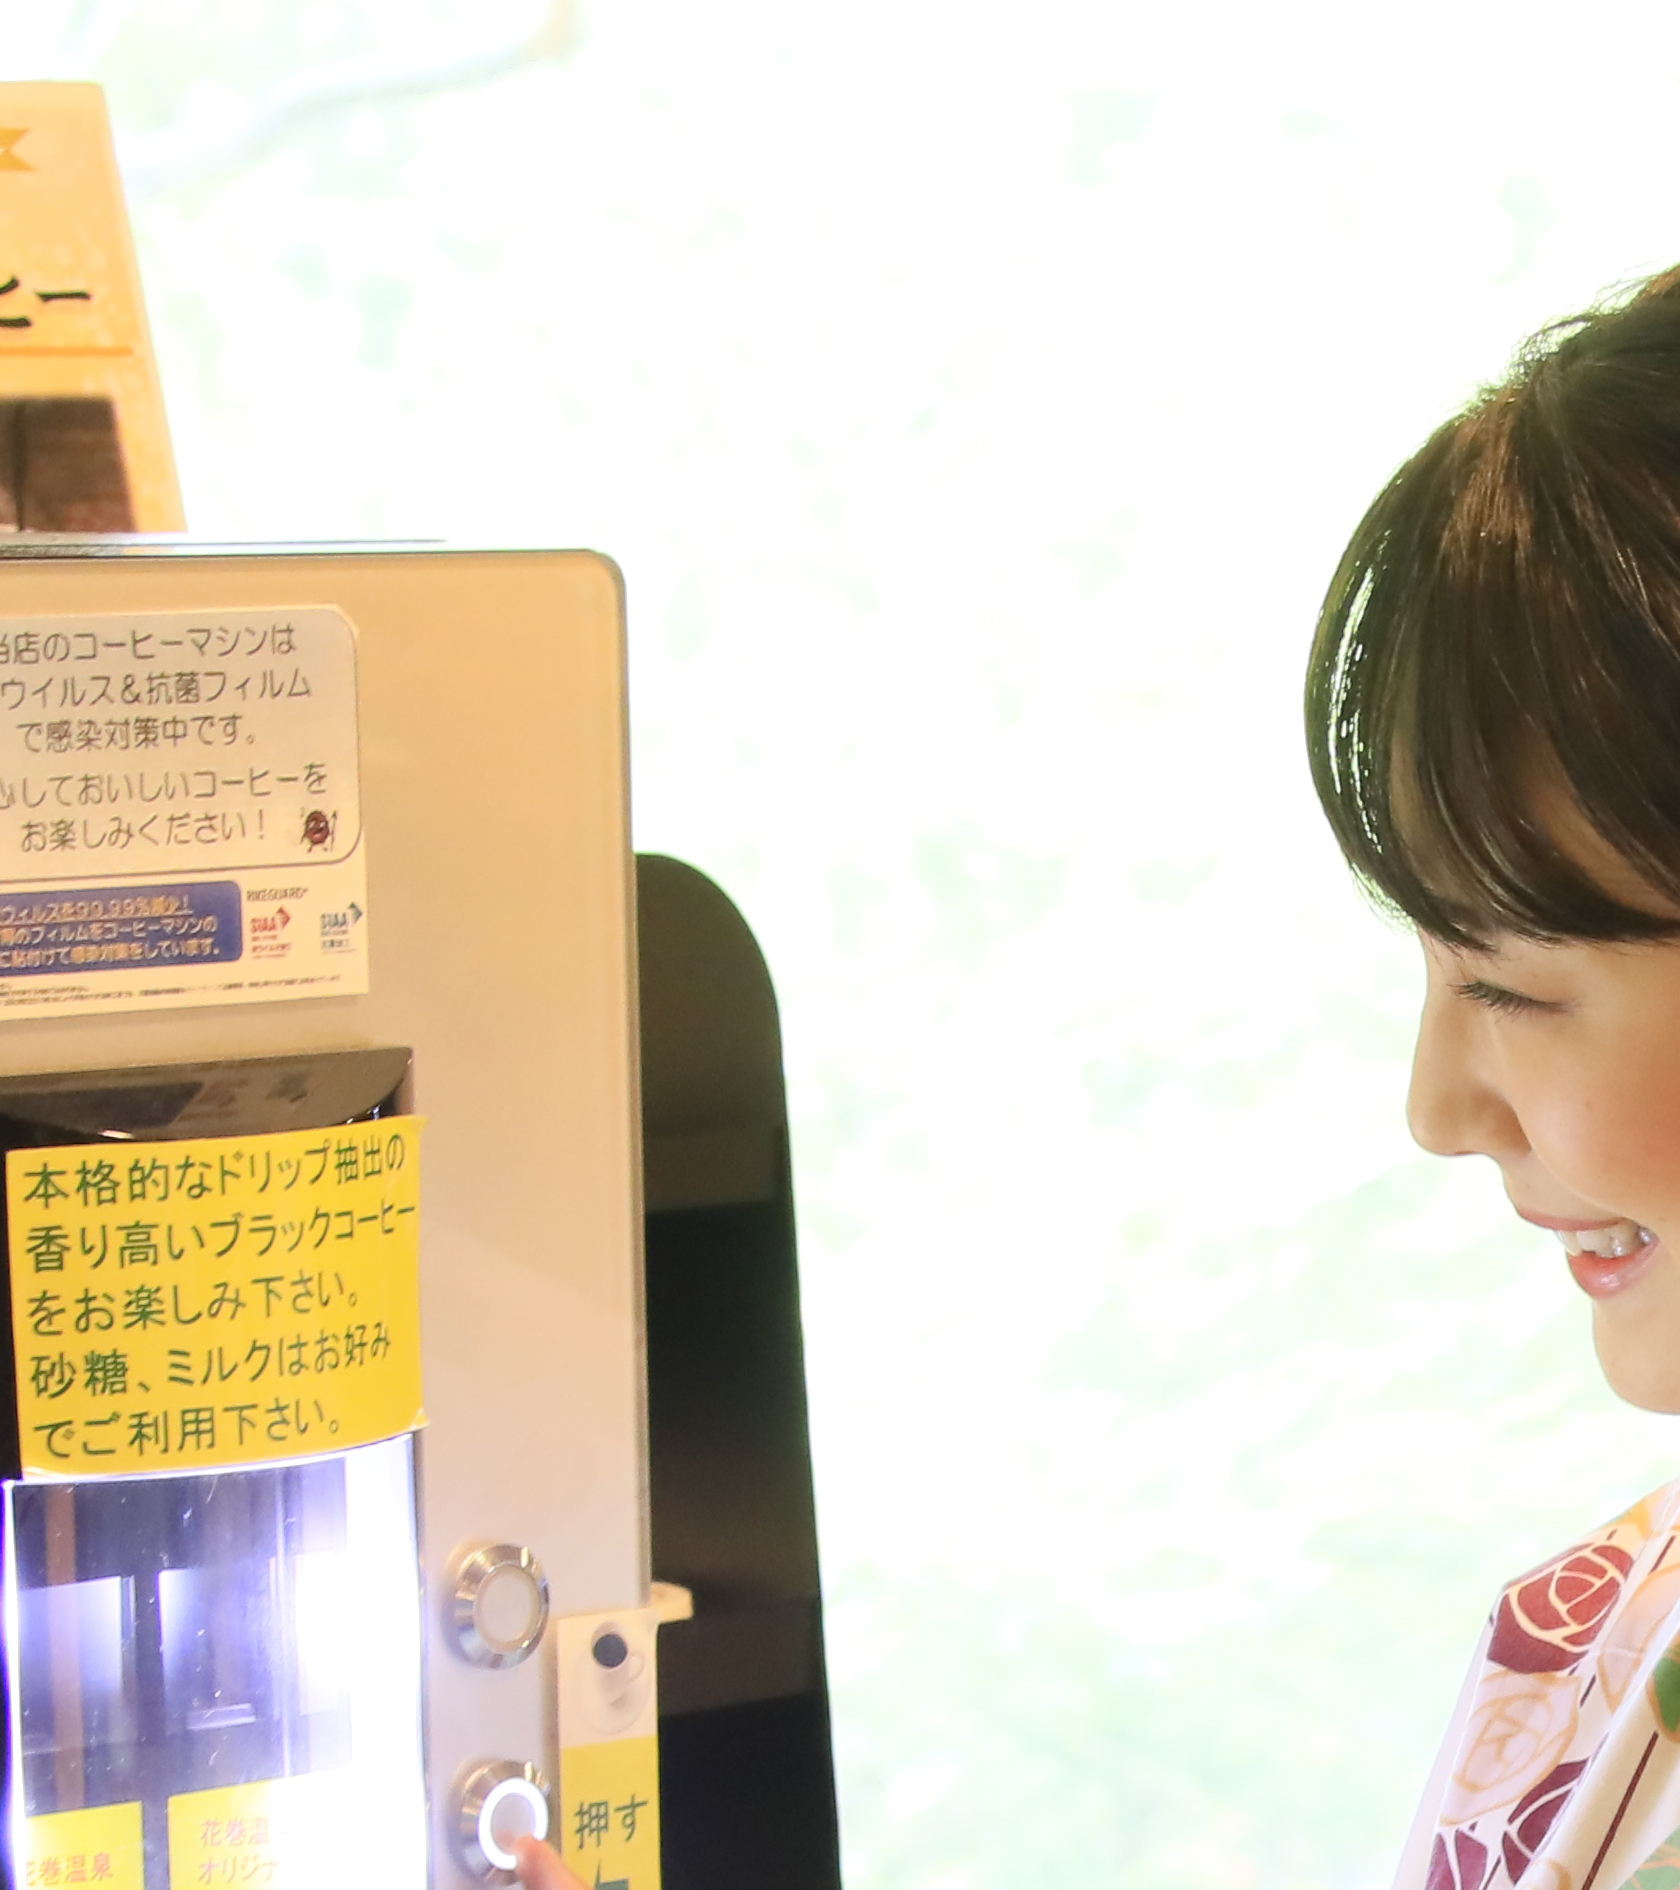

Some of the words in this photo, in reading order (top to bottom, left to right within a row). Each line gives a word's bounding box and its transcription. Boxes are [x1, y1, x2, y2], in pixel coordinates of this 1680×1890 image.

[17, 713, 256, 752] で感染対策中です。
[23, 1133, 405, 1209] 本格的なドリップ抽出の
[26, 1200, 416, 1273] 香り高いブラックコーヒー
[28, 1269, 357, 1337] をお楽しみ下さい。
[29, 1321, 391, 1399] 砂糖、ミルクはお好み
[34, 1398, 338, 1458] でご利用下さい。
[575, 1794, 648, 1850] 押す
